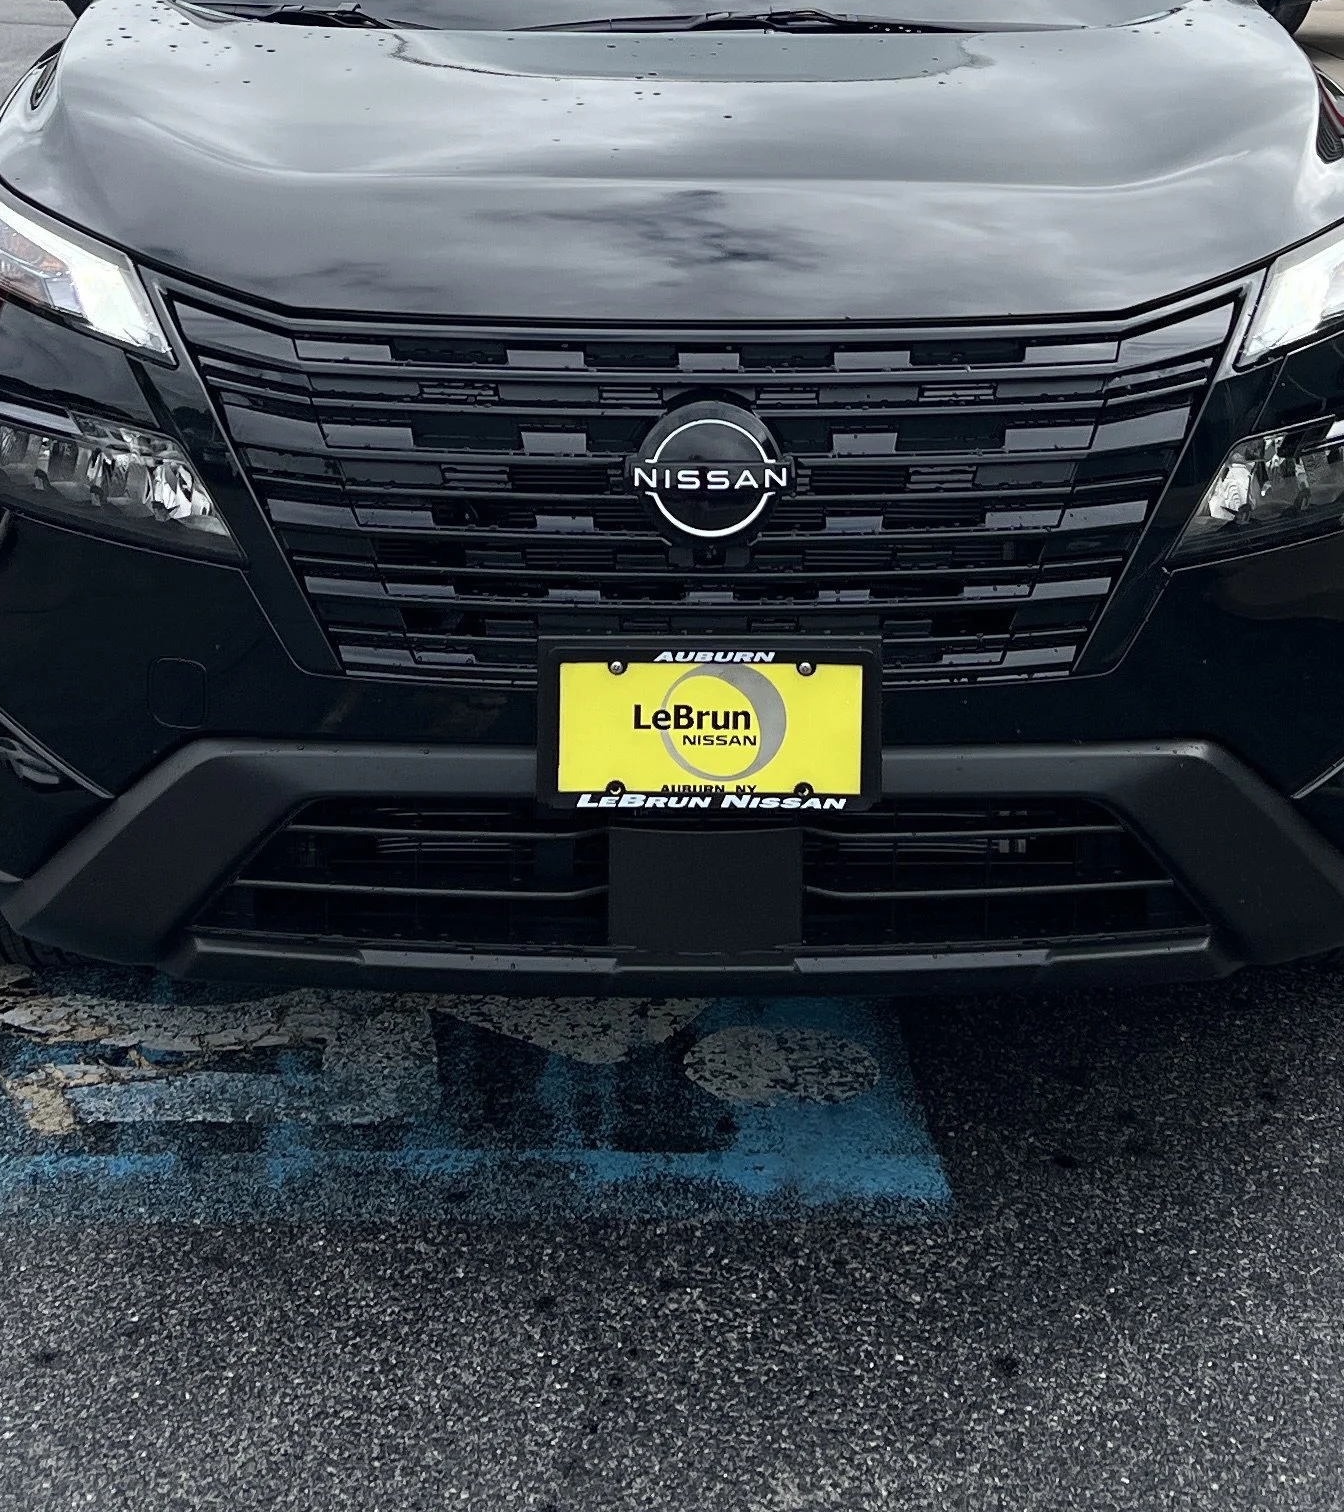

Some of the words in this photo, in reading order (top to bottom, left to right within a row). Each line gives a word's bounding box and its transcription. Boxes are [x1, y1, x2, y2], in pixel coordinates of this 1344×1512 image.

[634, 467, 787, 490] NISSAN
[653, 651, 776, 663] AUBURN
[633, 704, 751, 731] LeBrun
[682, 735, 757, 746] NISSAN
[736, 784, 757, 793] NY
[720, 794, 847, 810] NISSAN
